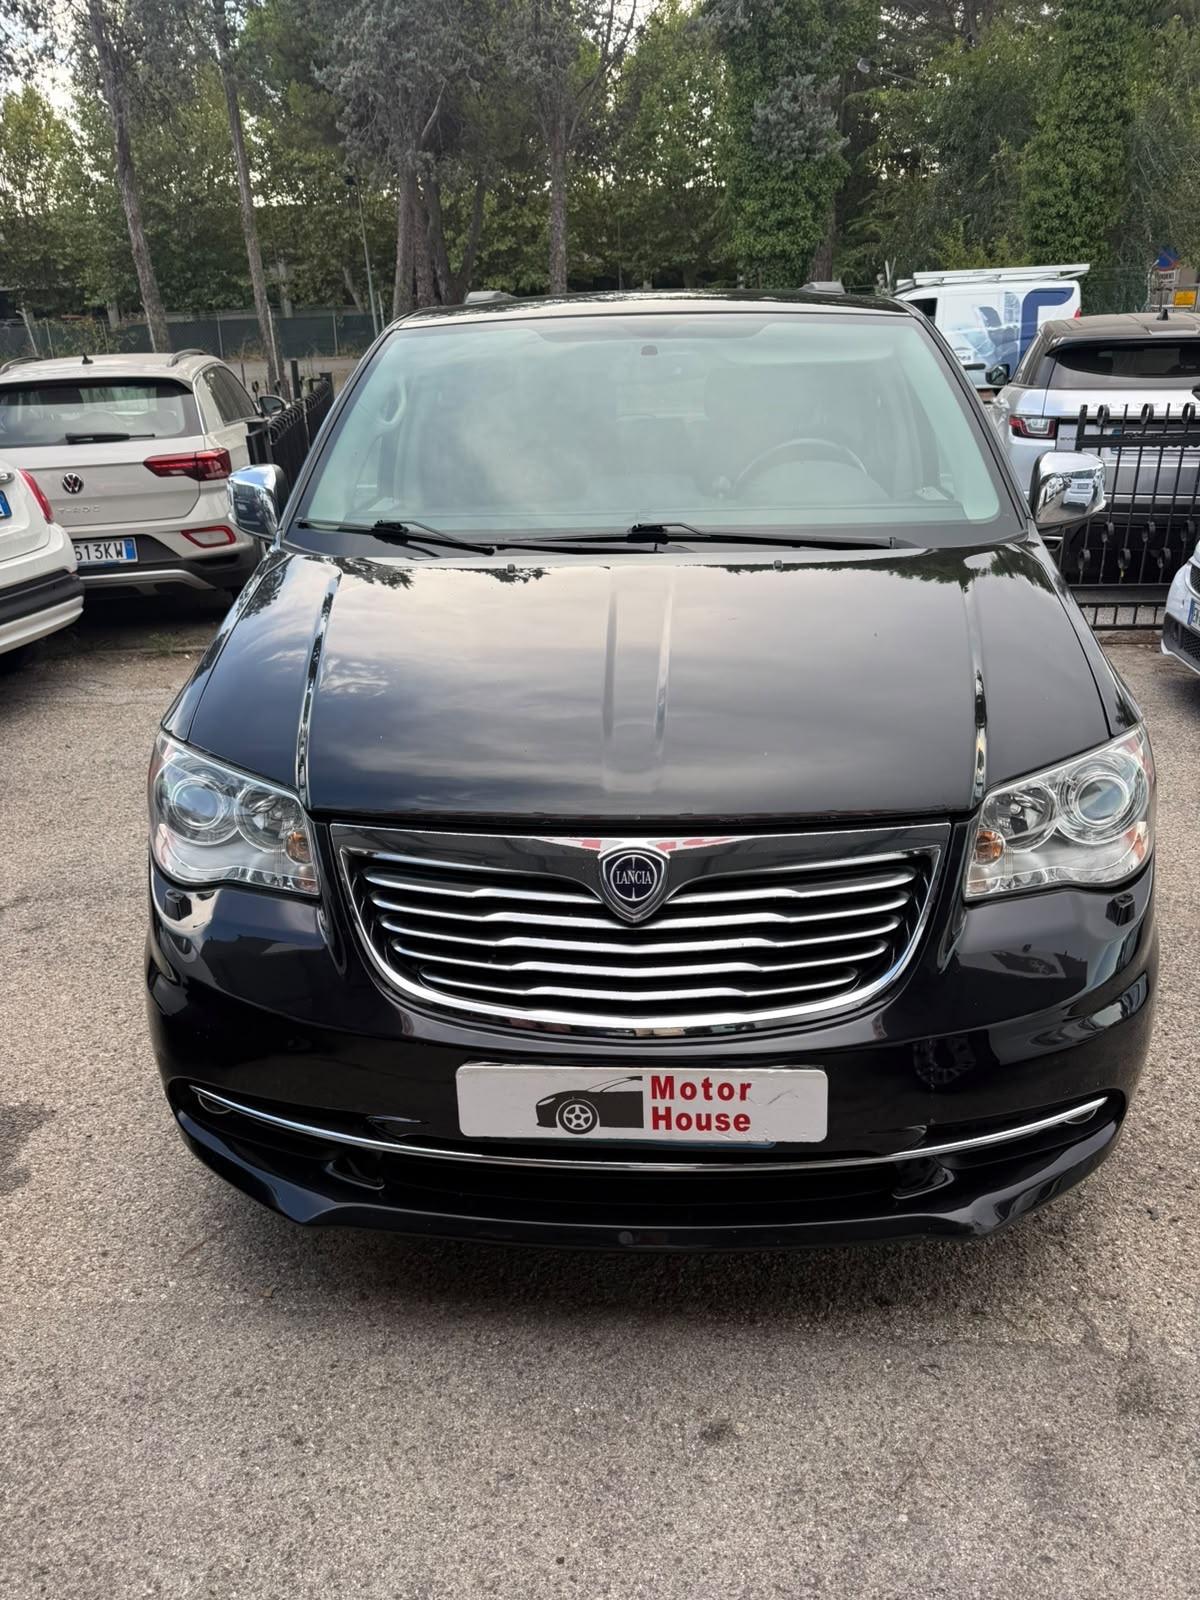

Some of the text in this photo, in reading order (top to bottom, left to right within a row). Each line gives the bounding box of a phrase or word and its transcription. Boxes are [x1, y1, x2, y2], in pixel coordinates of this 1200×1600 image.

[616, 870, 653, 885] LANCIA
[650, 1075, 752, 1101] Motor
[651, 1106, 751, 1132] House
